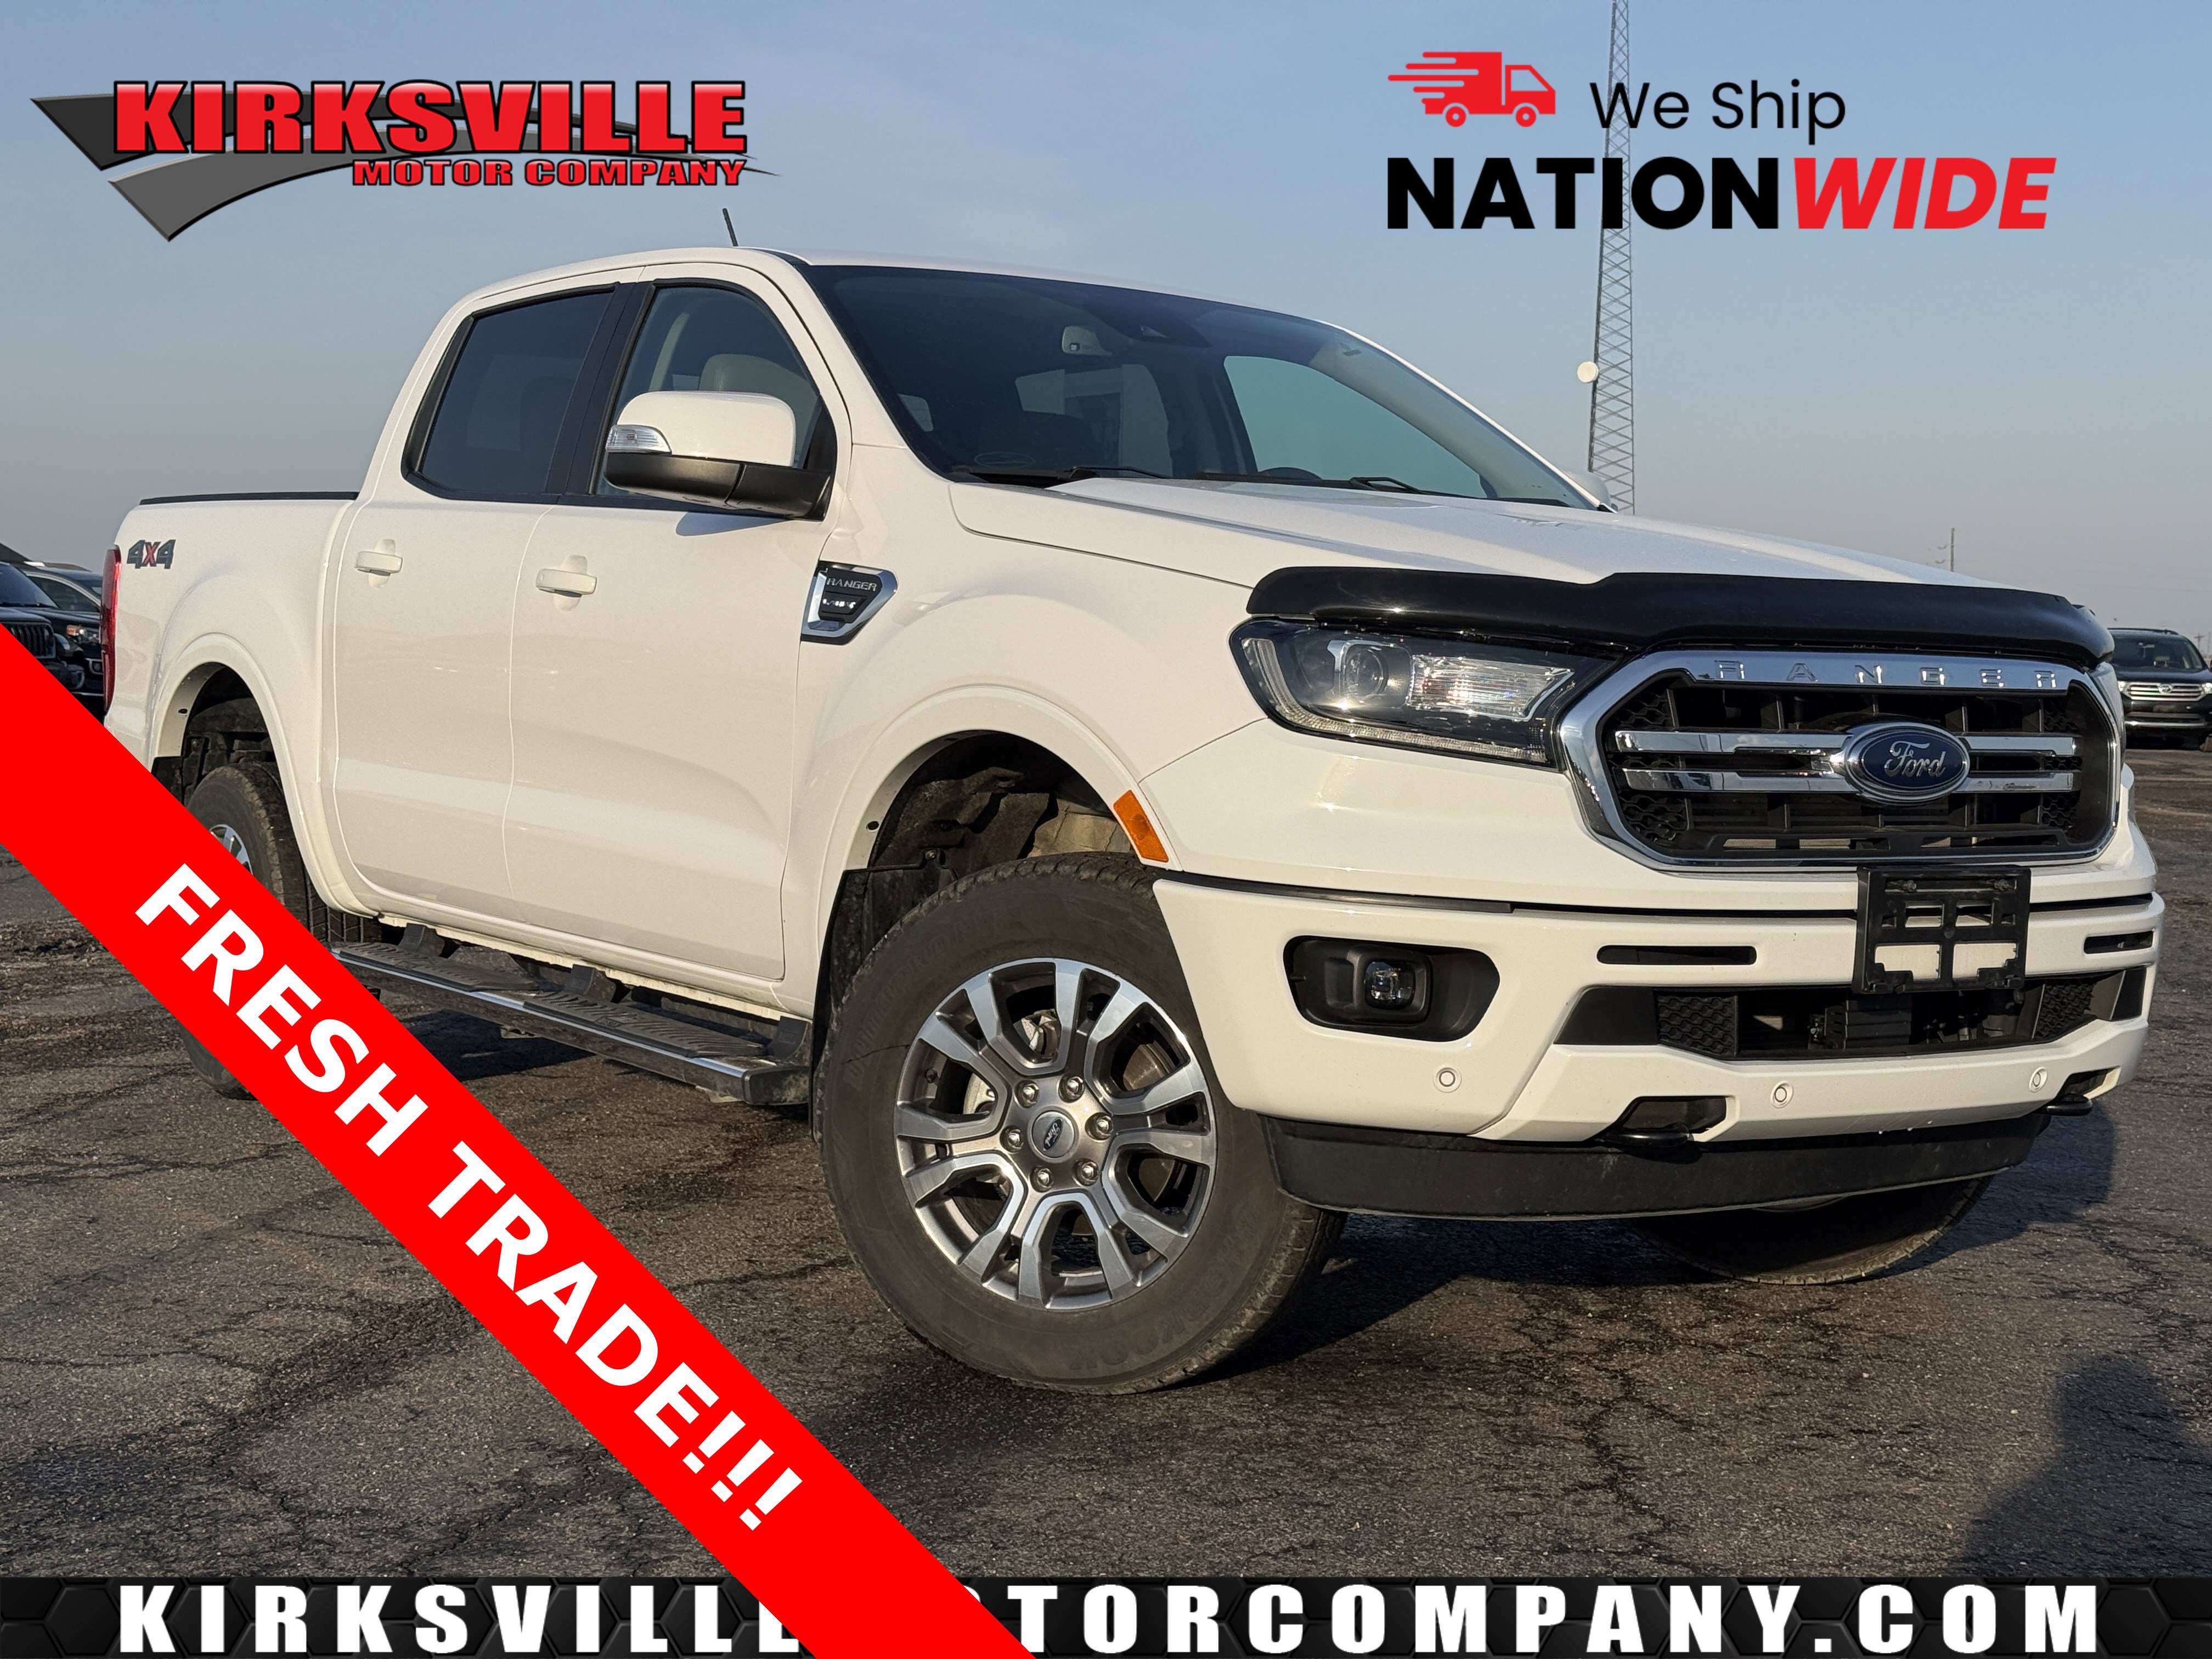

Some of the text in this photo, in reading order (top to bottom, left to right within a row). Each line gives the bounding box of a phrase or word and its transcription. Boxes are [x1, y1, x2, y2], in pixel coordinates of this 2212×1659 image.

[826, 577, 877, 592] RANGER
[1713, 659, 2057, 688] RANGER
[1884, 741, 1946, 777] Ford
